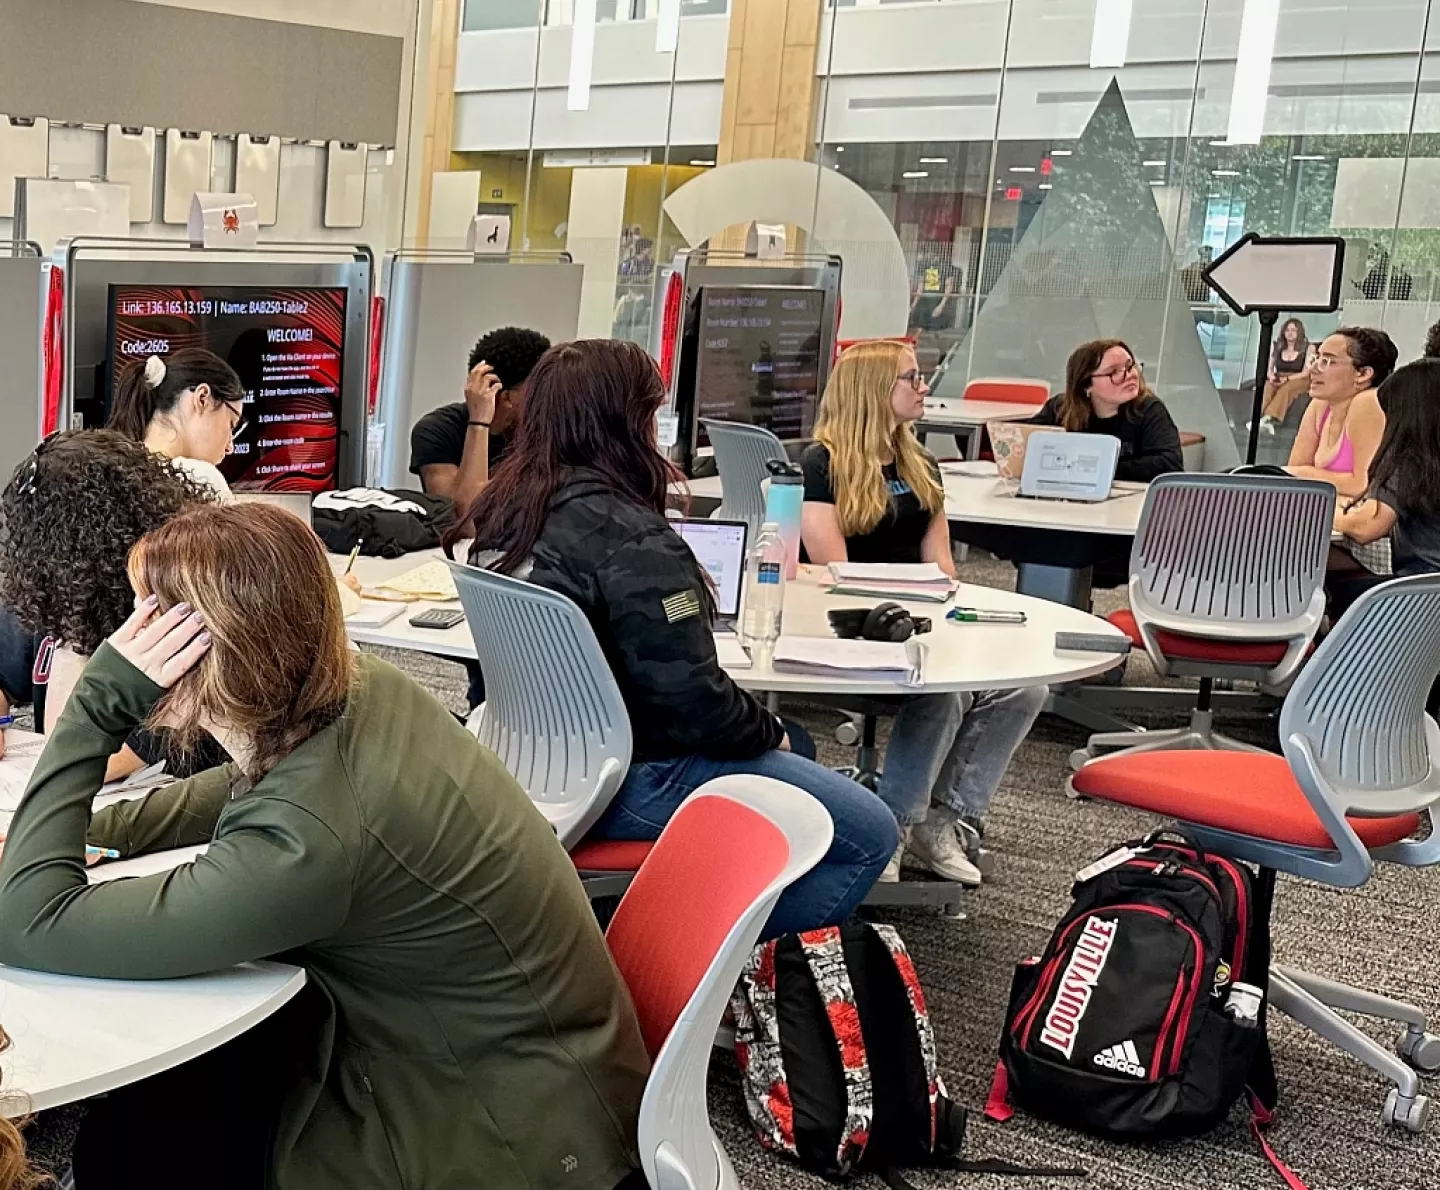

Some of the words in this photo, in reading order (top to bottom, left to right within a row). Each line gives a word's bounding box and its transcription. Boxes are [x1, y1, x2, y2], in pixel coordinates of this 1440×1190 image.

[123, 301, 144, 314] Link:
[147, 301, 212, 315] 136.165.13.159
[220, 302, 247, 315] Name:
[249, 301, 309, 315] BAB250-Table2
[266, 329, 313, 342] WELCOME!
[234, 443, 250, 454] 2023
[1041, 917, 1116, 1057] LOUISVILLE
[1094, 1053, 1146, 1078] adidas
